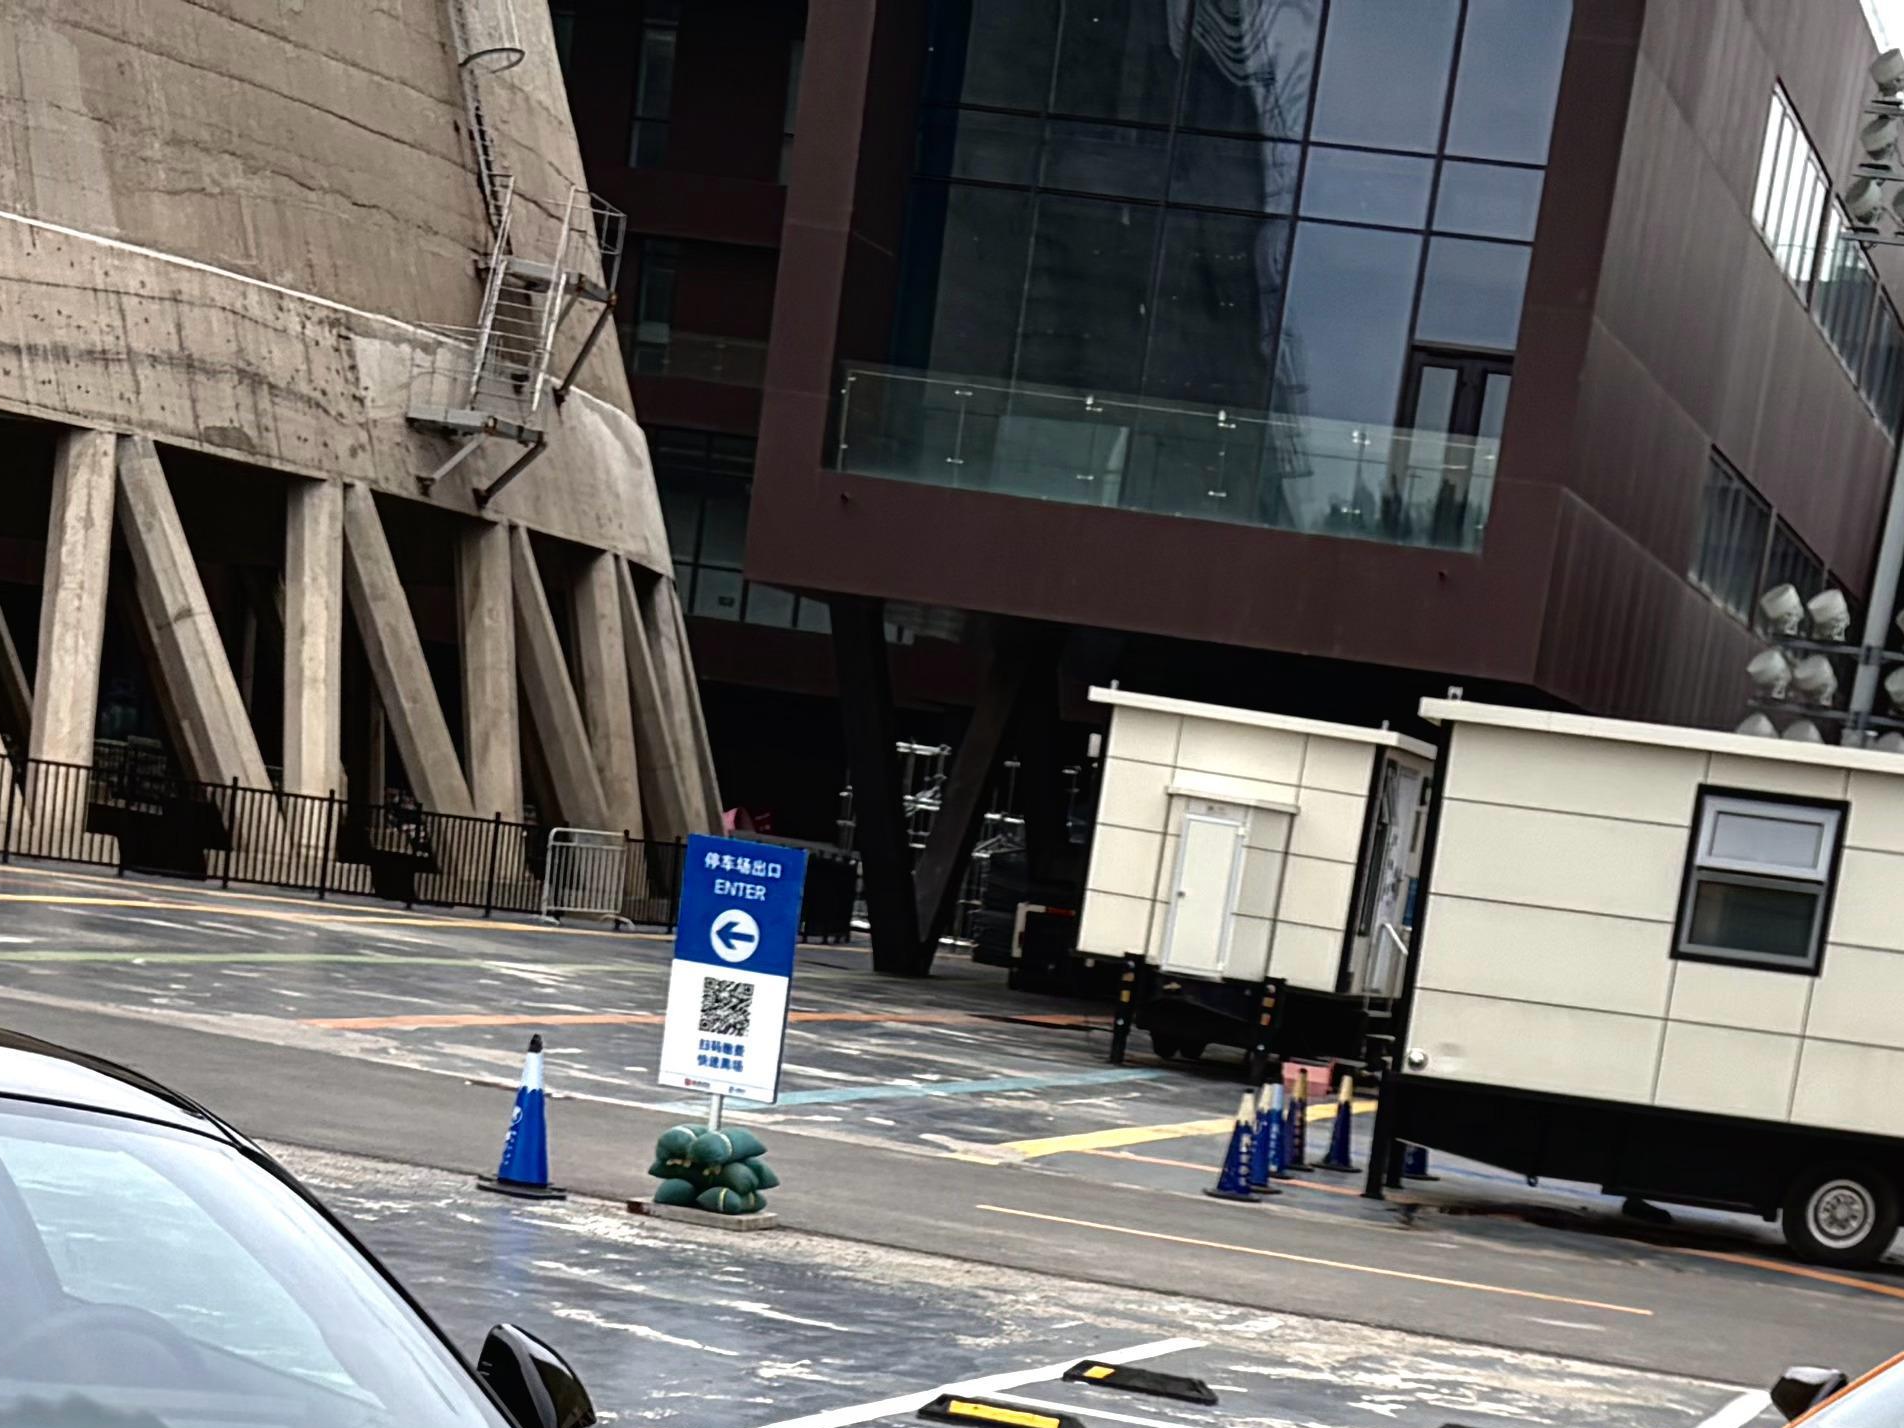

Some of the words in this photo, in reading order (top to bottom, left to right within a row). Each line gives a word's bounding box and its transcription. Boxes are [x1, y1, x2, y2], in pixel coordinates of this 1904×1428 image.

[704, 852, 782, 878] 停车场出口
[714, 879, 766, 901] ENTER
